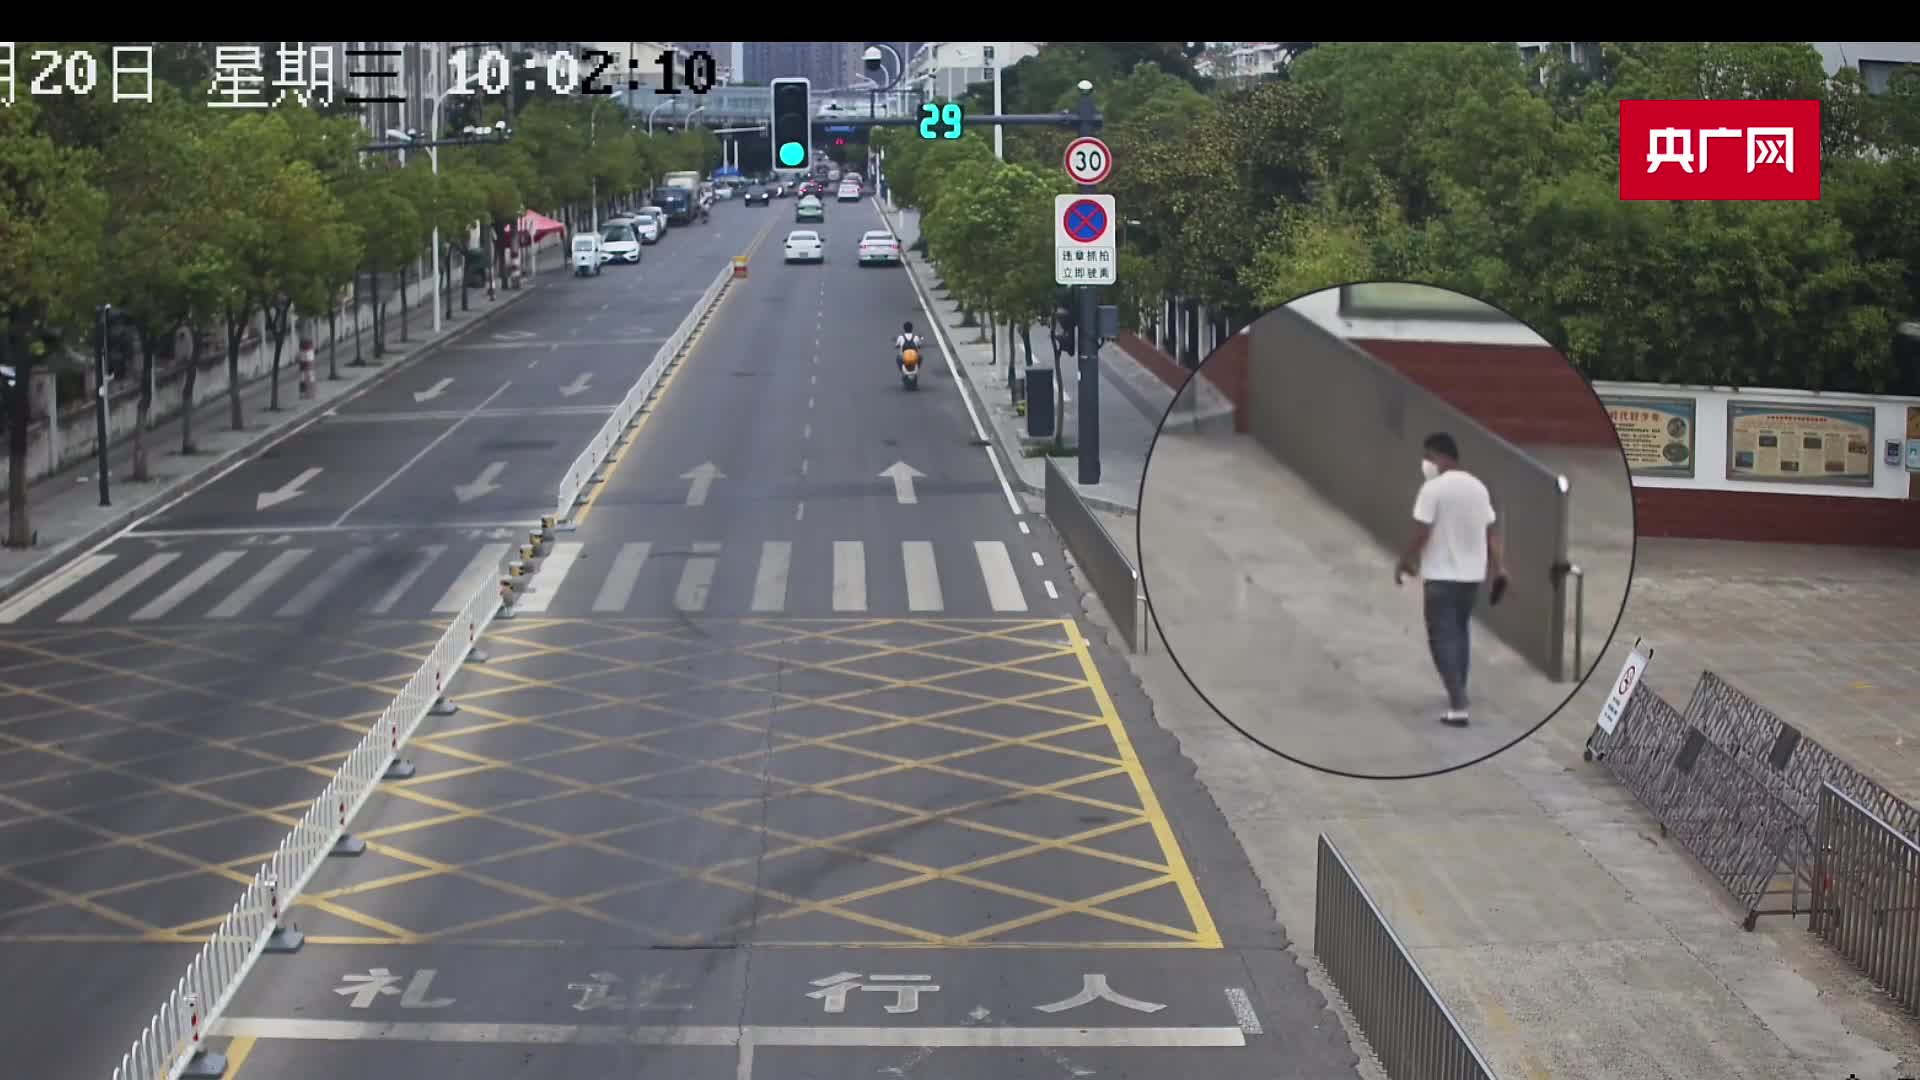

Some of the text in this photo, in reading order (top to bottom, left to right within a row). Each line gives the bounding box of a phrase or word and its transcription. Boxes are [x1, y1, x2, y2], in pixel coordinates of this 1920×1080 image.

[920, 103, 963, 139] 29
[1075, 151, 1101, 172] 30
[1062, 250, 1110, 262] 违章抓拍
[1063, 267, 1110, 279] 立即驶离
